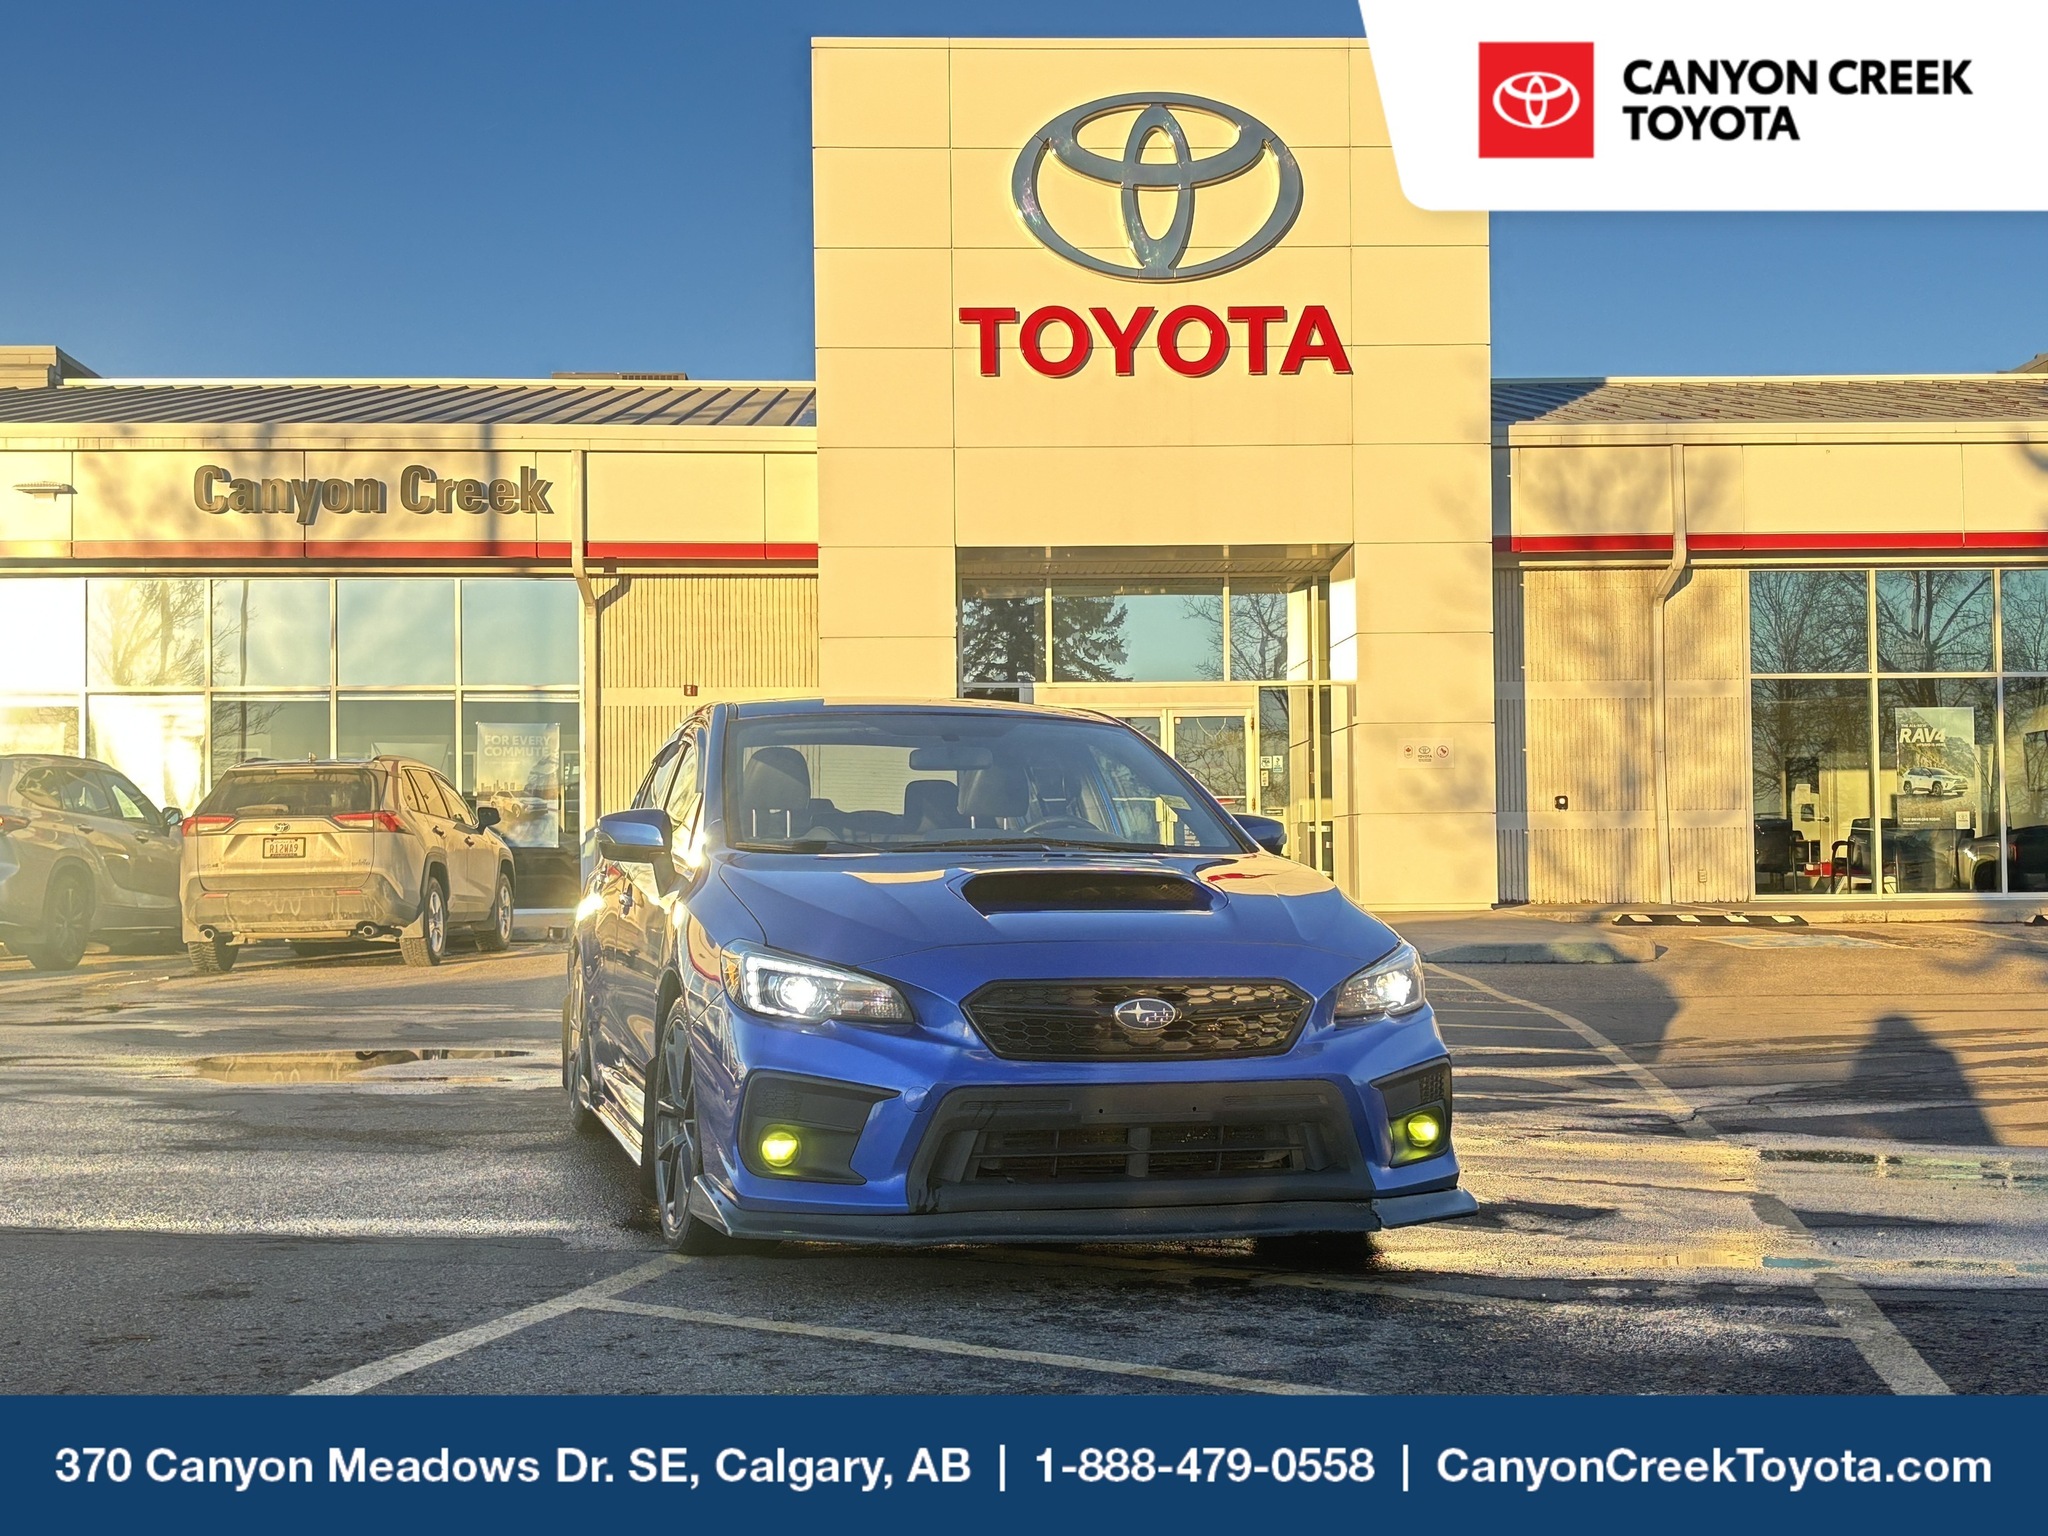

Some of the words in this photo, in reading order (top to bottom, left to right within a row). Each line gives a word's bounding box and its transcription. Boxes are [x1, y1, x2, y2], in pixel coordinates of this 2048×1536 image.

[959, 304, 1353, 378] TOYOTA
[194, 464, 387, 525] Canyon
[401, 464, 554, 514] Creek
[485, 736, 509, 745] FOR
[513, 736, 550, 745] EVERY
[1899, 728, 1946, 743] RAV4
[485, 747, 549, 756] COMMUTE
